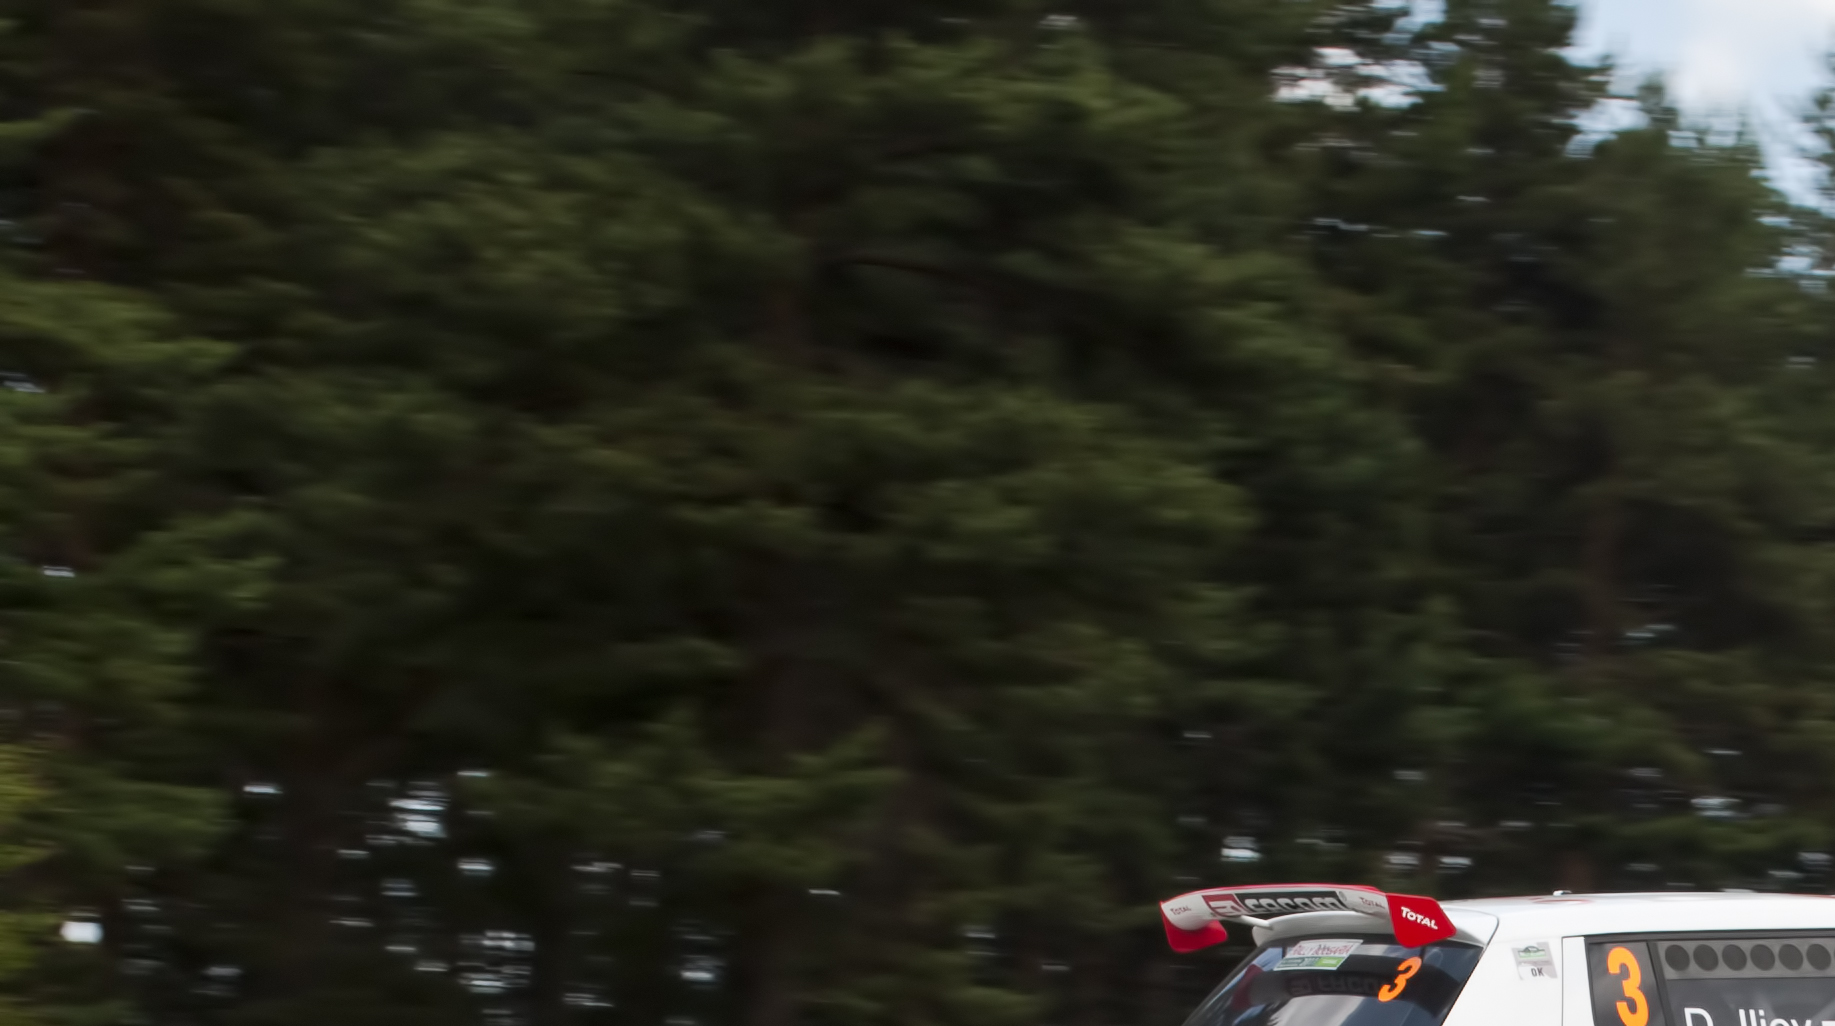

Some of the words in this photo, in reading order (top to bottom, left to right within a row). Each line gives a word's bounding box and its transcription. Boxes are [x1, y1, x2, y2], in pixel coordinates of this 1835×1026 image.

[1360, 896, 1387, 909] TOTAL
[1170, 905, 1192, 916] TOTAL
[1401, 906, 1439, 930] TOTAL
[1530, 967, 1545, 977] OK
[1378, 957, 1422, 1002] 3
